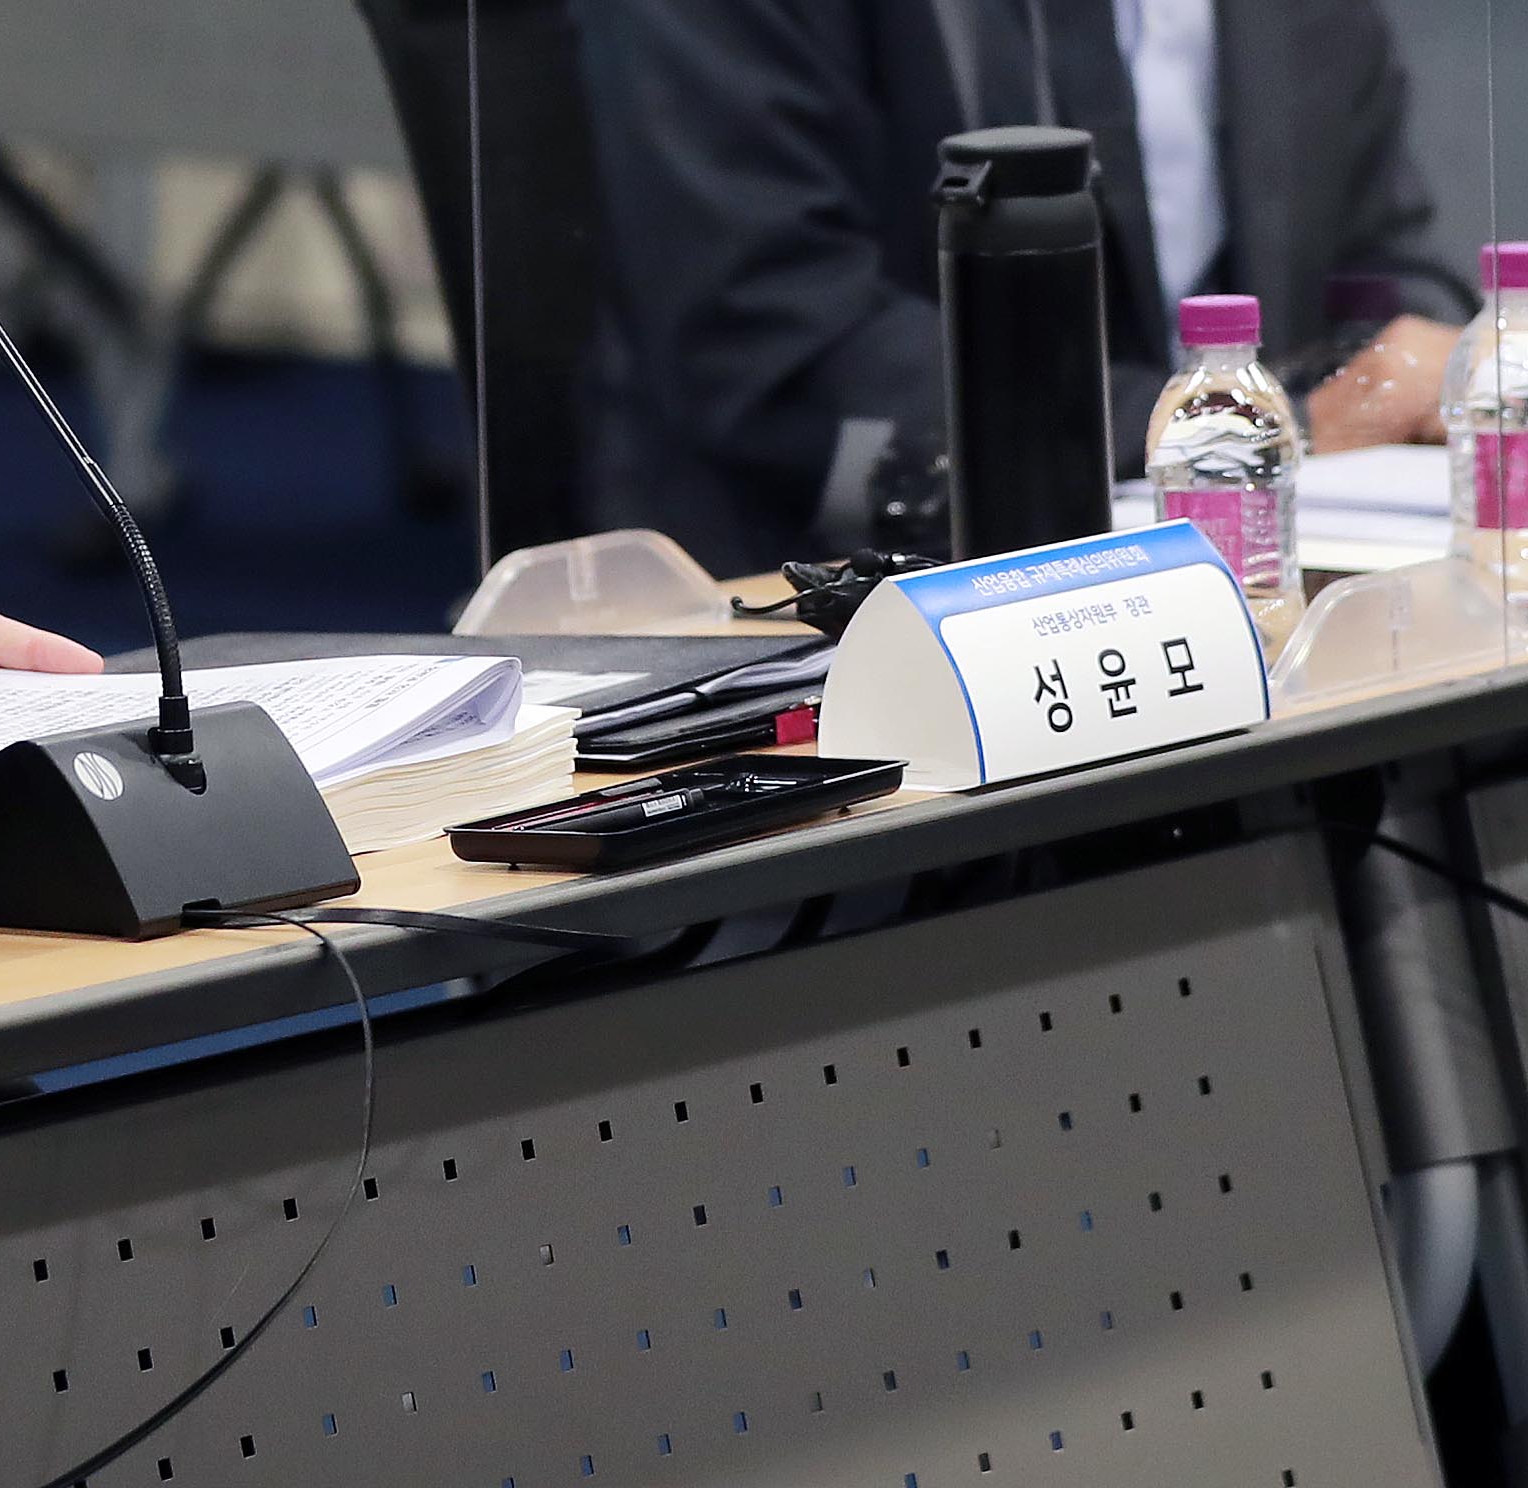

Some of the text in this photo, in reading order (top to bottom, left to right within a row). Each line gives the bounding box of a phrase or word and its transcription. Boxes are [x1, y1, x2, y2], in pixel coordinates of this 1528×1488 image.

[971, 568, 1031, 597] 산업융합
[1031, 595, 1153, 637] 산업통상자원부 장관
